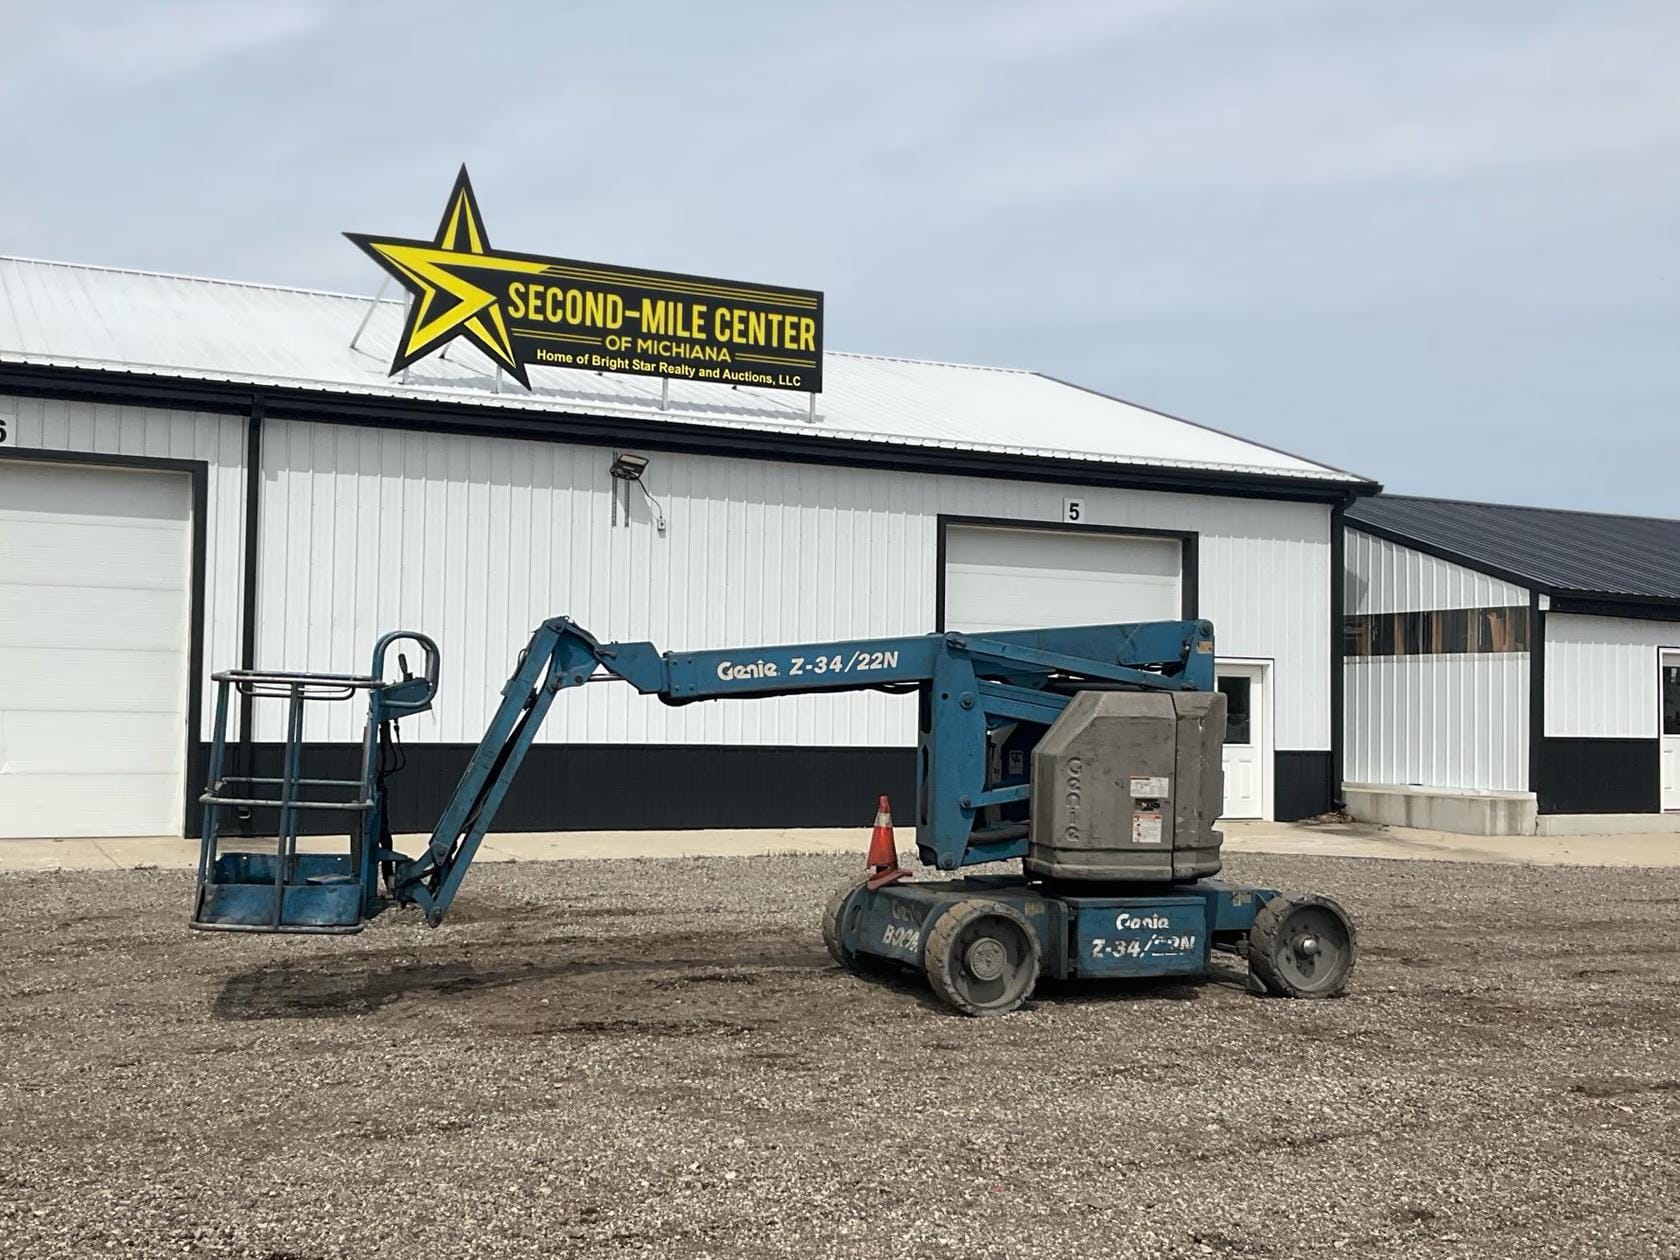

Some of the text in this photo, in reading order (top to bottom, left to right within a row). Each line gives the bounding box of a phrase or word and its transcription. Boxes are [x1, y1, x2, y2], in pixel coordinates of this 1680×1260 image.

[508, 282, 816, 352] SECOND-MILE CENTER
[605, 335, 732, 363] OF MICHIANA
[536, 349, 801, 387] Home of Bright Star Realty and Auctions, LLC
[1069, 502, 1080, 521] 5
[717, 651, 899, 681] Genie Z-34/22N
